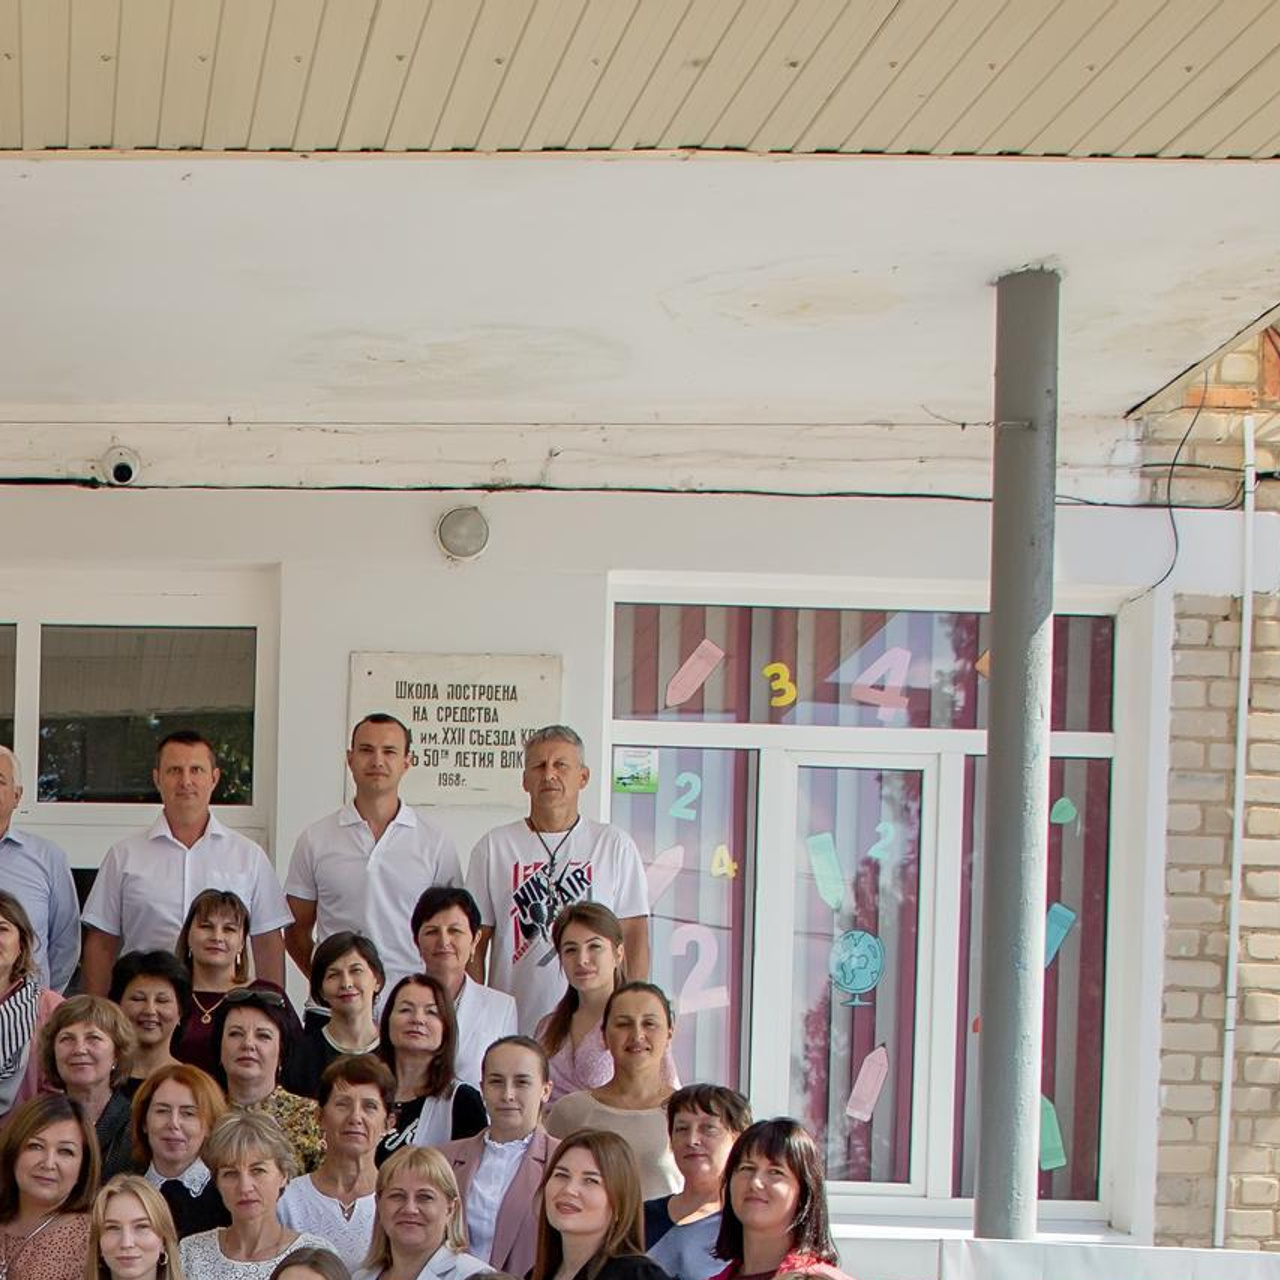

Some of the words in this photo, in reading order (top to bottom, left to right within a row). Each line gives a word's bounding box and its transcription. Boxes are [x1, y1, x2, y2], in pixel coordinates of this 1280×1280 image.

[395, 680, 439, 700] ШКОЛА
[446, 683, 519, 701] ПОСТРОЕНА
[412, 705, 428, 721] НА
[436, 705, 499, 723] СРЕДСТВА
[468, 729, 517, 746] СЪЕЗДА
[454, 751, 495, 769] ЛЕТИЯ
